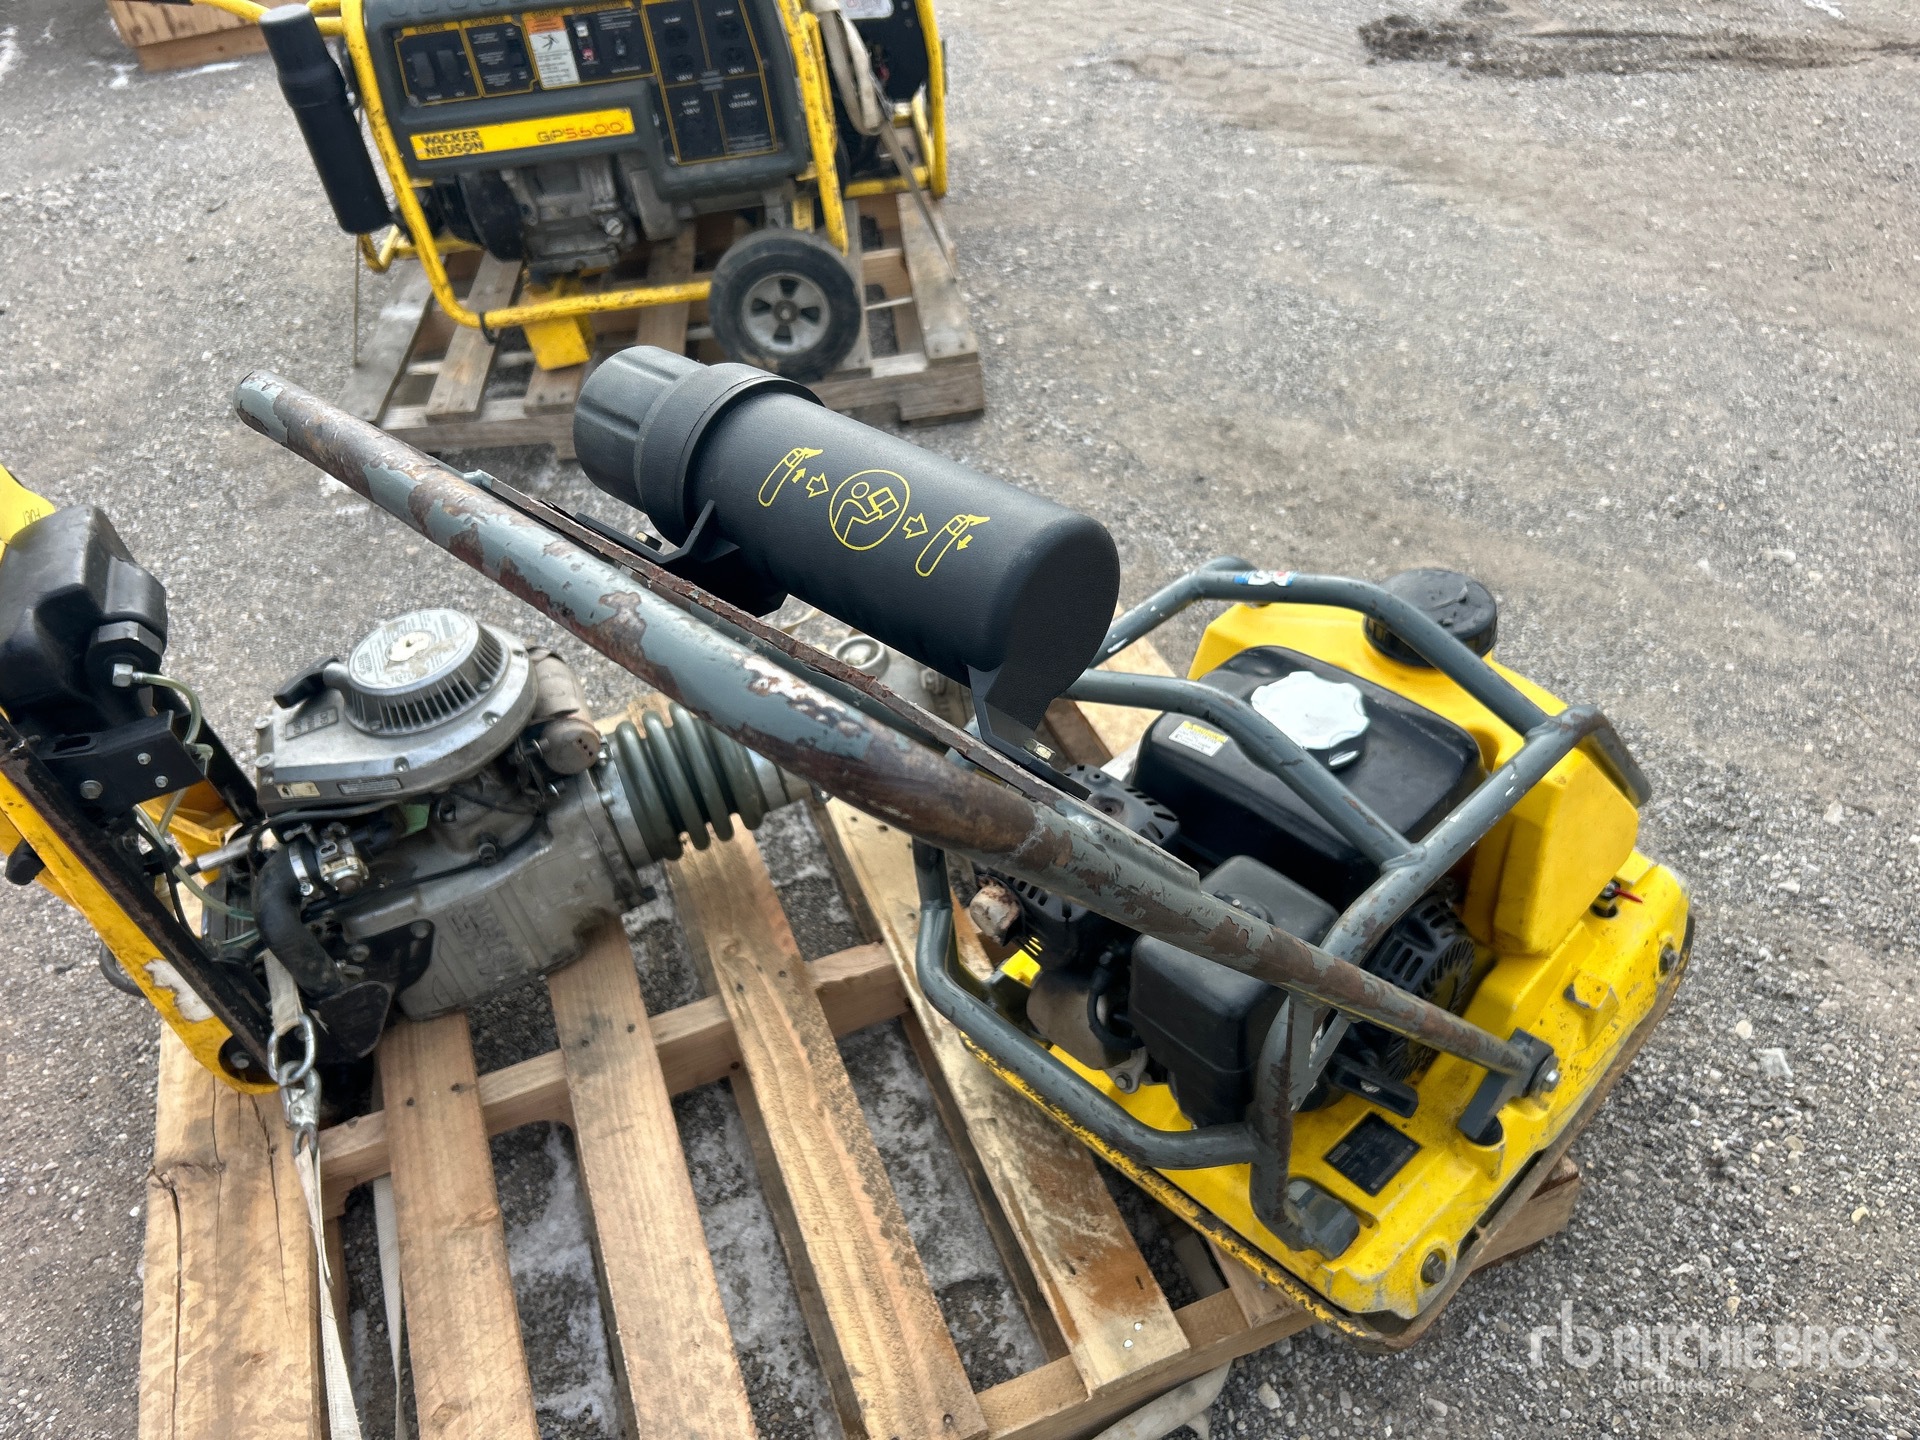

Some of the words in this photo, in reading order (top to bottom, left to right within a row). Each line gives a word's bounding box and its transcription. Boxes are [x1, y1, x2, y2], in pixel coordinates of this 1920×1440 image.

[420, 130, 481, 147] WACKER
[536, 121, 624, 143] GP5600
[424, 141, 485, 157] NEUSON
